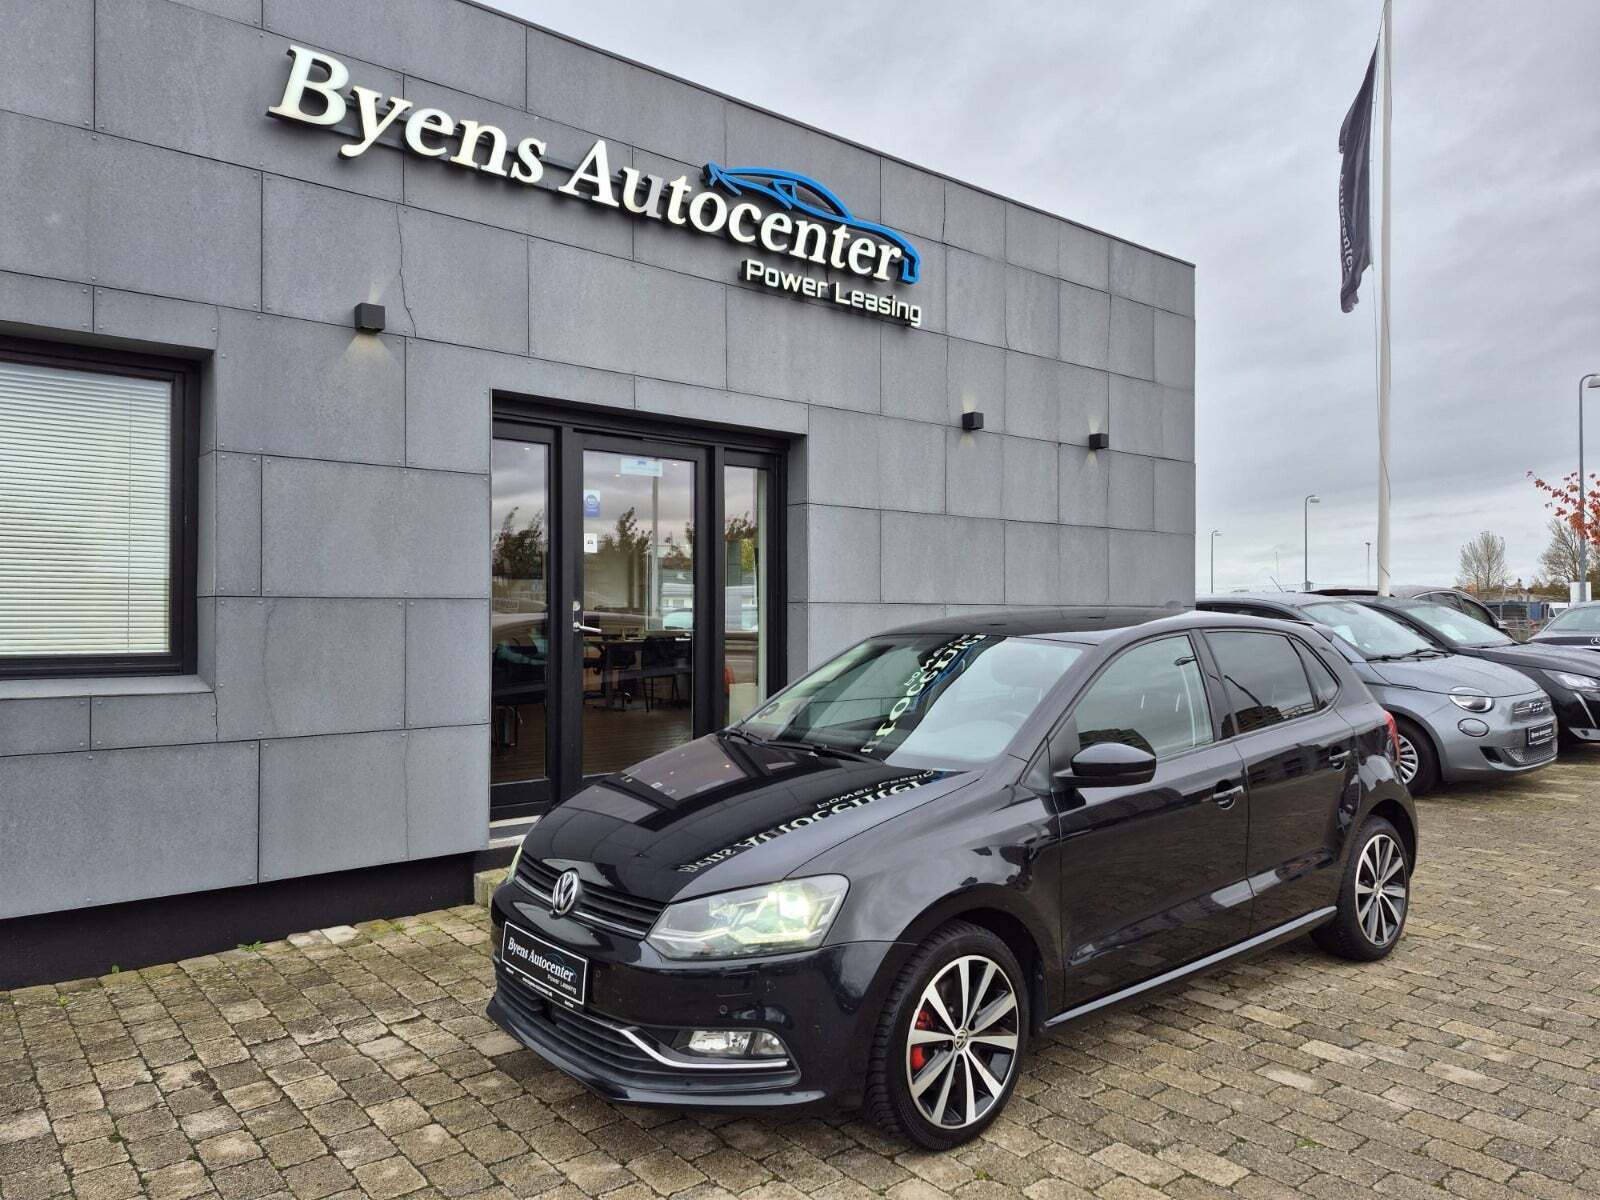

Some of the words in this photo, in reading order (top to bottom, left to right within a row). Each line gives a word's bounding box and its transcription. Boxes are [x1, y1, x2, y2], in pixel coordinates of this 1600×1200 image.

[268, 44, 547, 184] Byens
[557, 139, 902, 281] Autocenter
[746, 258, 829, 298] Power
[836, 281, 922, 327] Leasing
[508, 936, 529, 959] Byens
[528, 949, 574, 982] Autocenter
